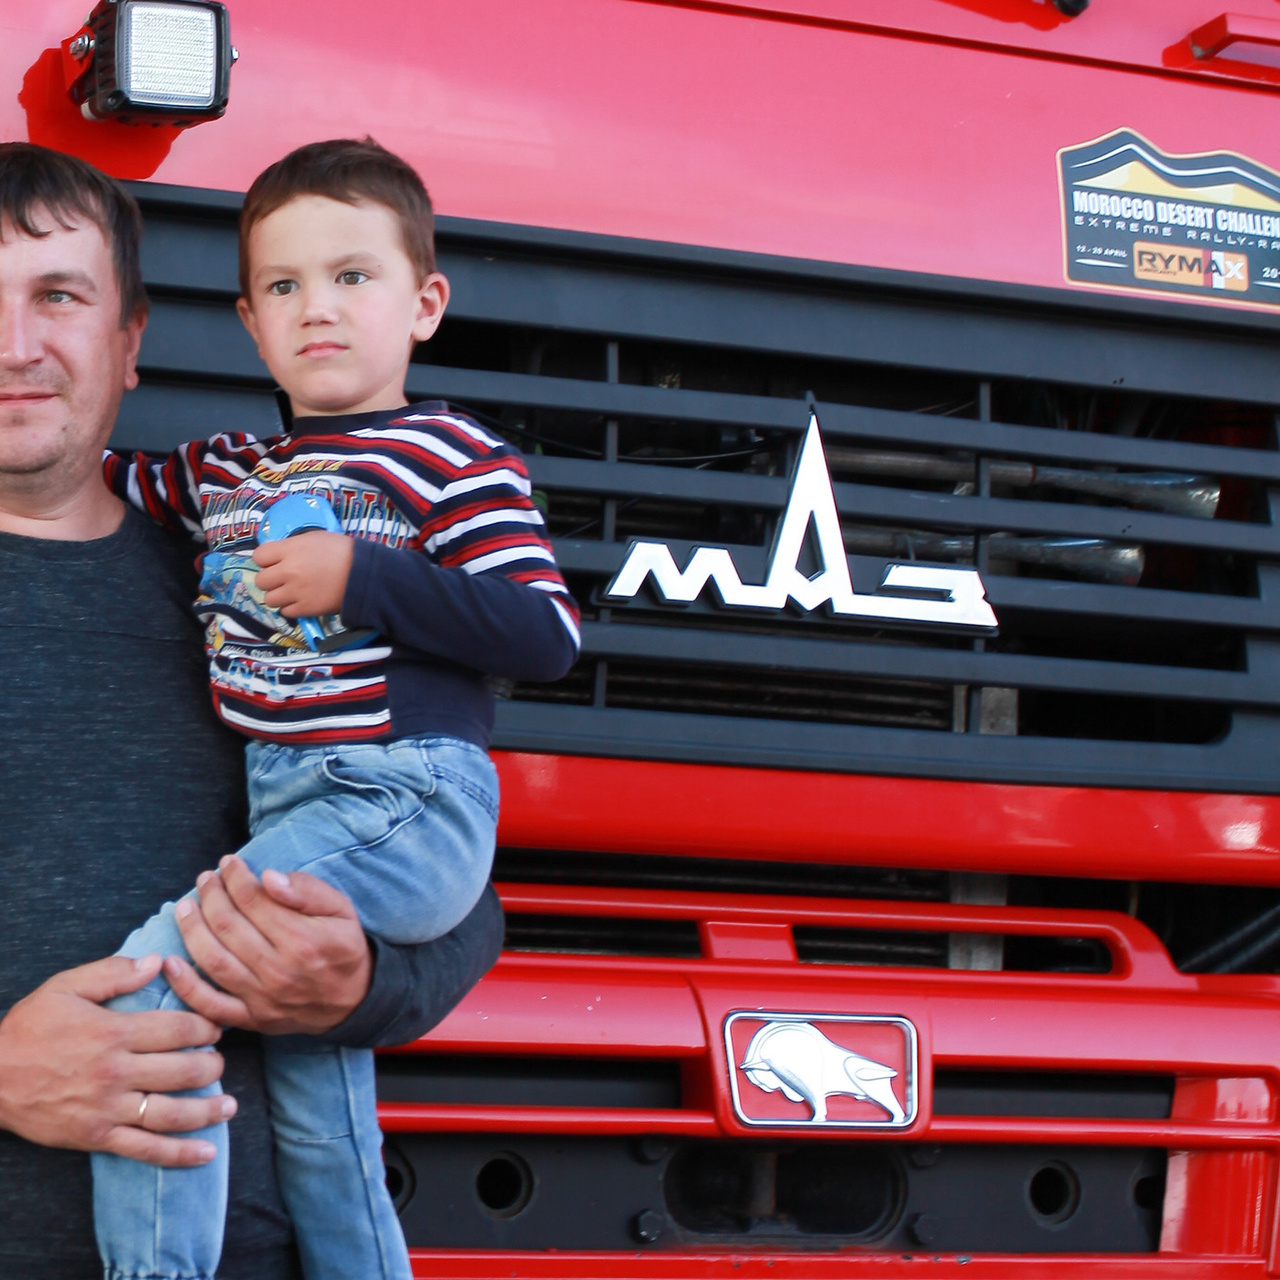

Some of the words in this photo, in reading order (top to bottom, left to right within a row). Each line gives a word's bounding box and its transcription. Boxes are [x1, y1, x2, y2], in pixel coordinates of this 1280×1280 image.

[1073, 191, 1155, 222] MOROCCO
[1156, 201, 1215, 230] DESERT
[1074, 215, 1173, 238] EXTREME
[1137, 250, 1245, 281] RYMAX
[1262, 266, 1280, 280] 20
